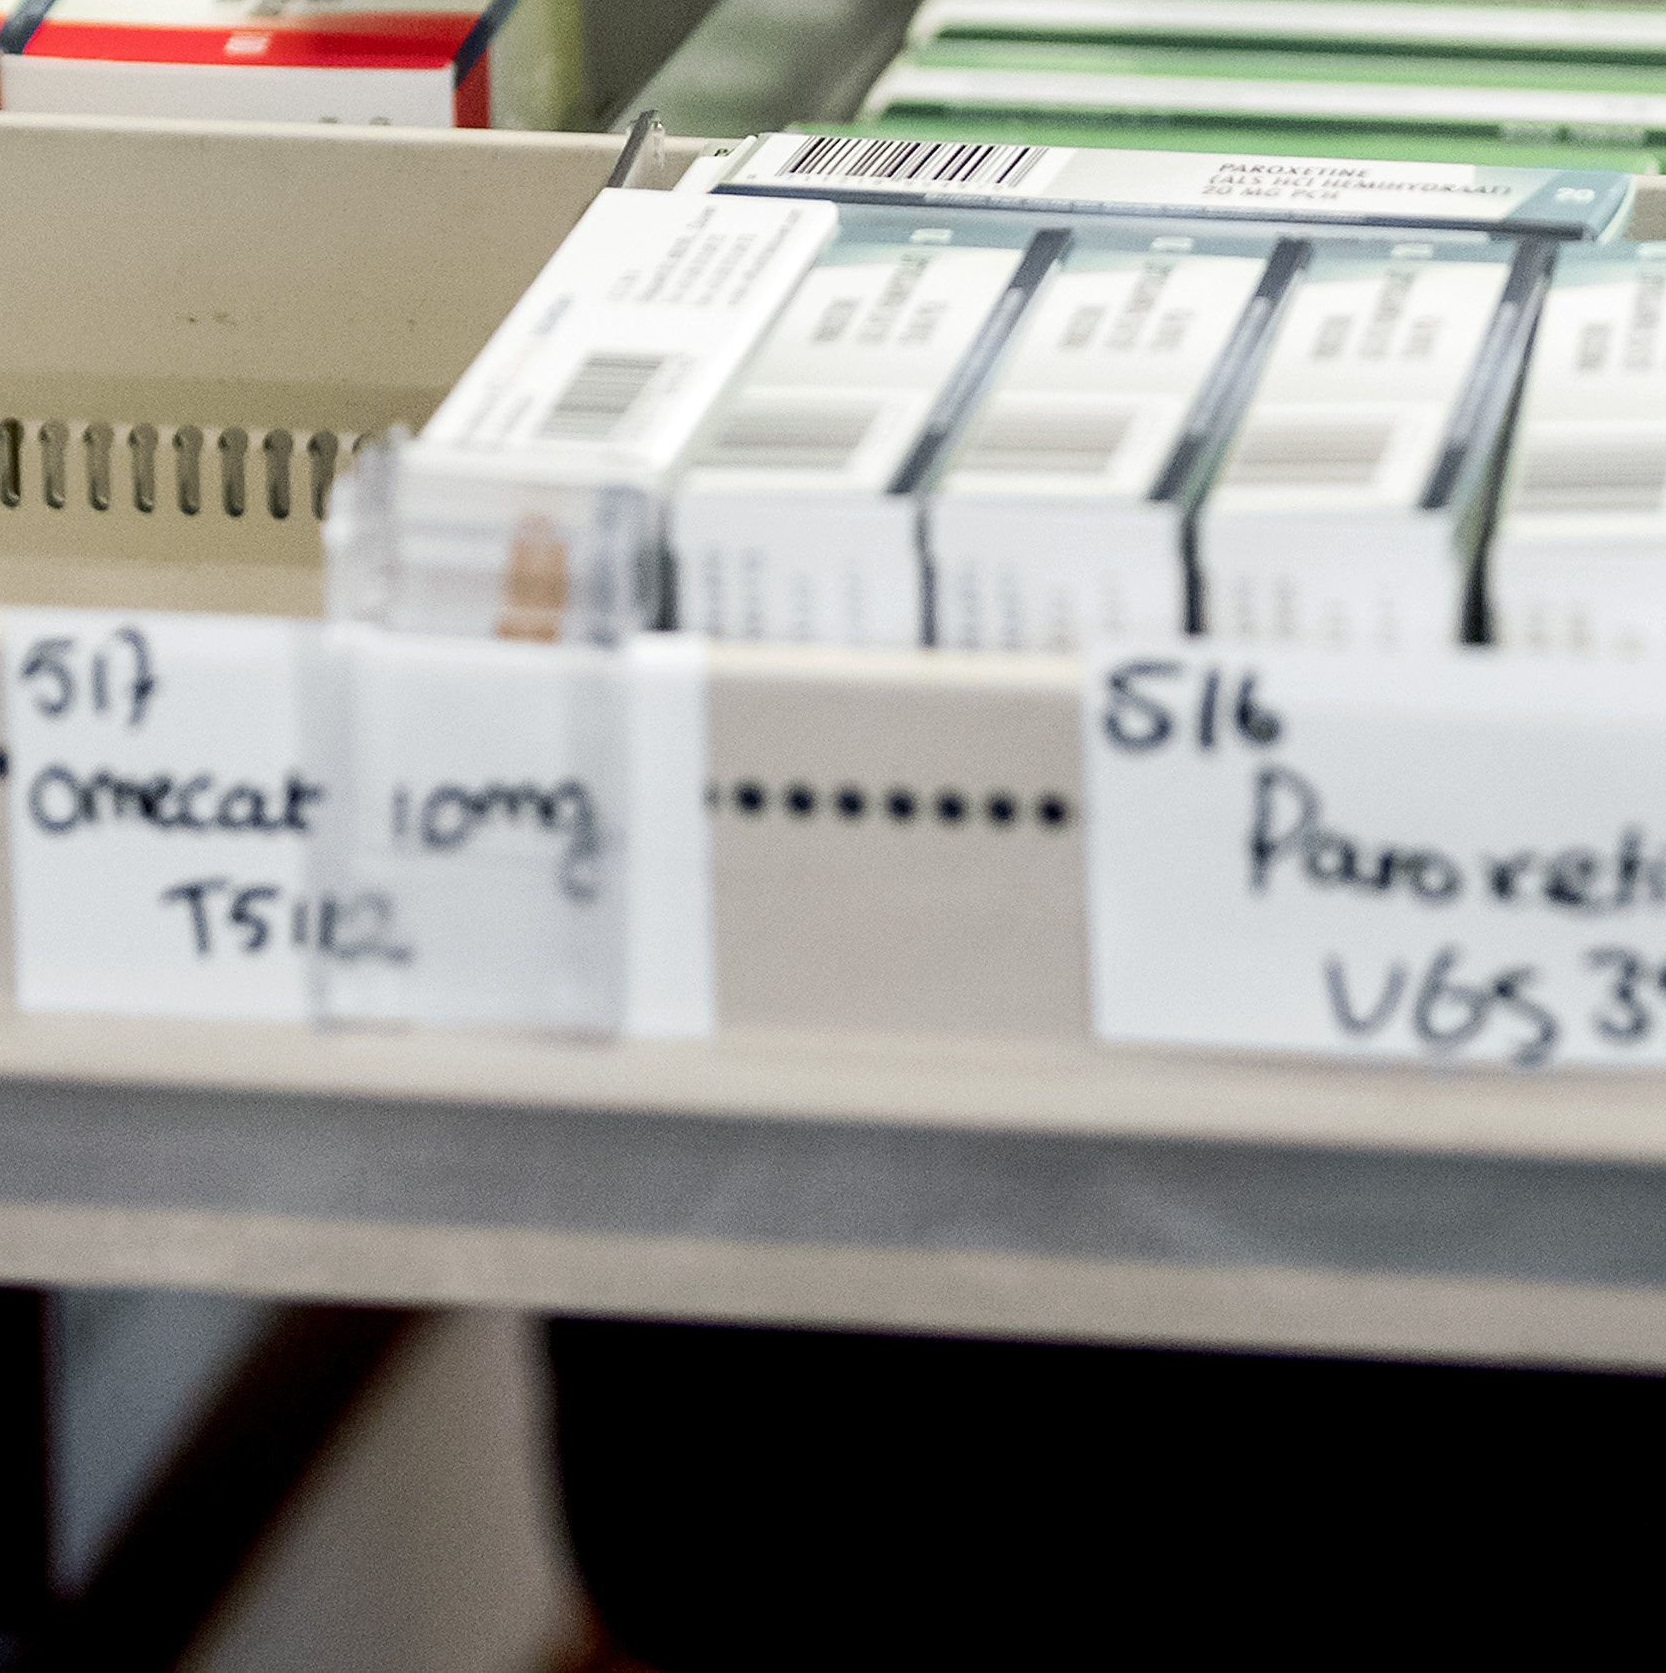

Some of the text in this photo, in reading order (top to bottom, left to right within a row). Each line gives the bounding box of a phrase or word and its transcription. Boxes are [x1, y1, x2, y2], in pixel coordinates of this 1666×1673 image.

[1218, 162, 1370, 180] PAROXETINE
[22, 626, 158, 727] 517
[1102, 661, 1282, 755] 516
